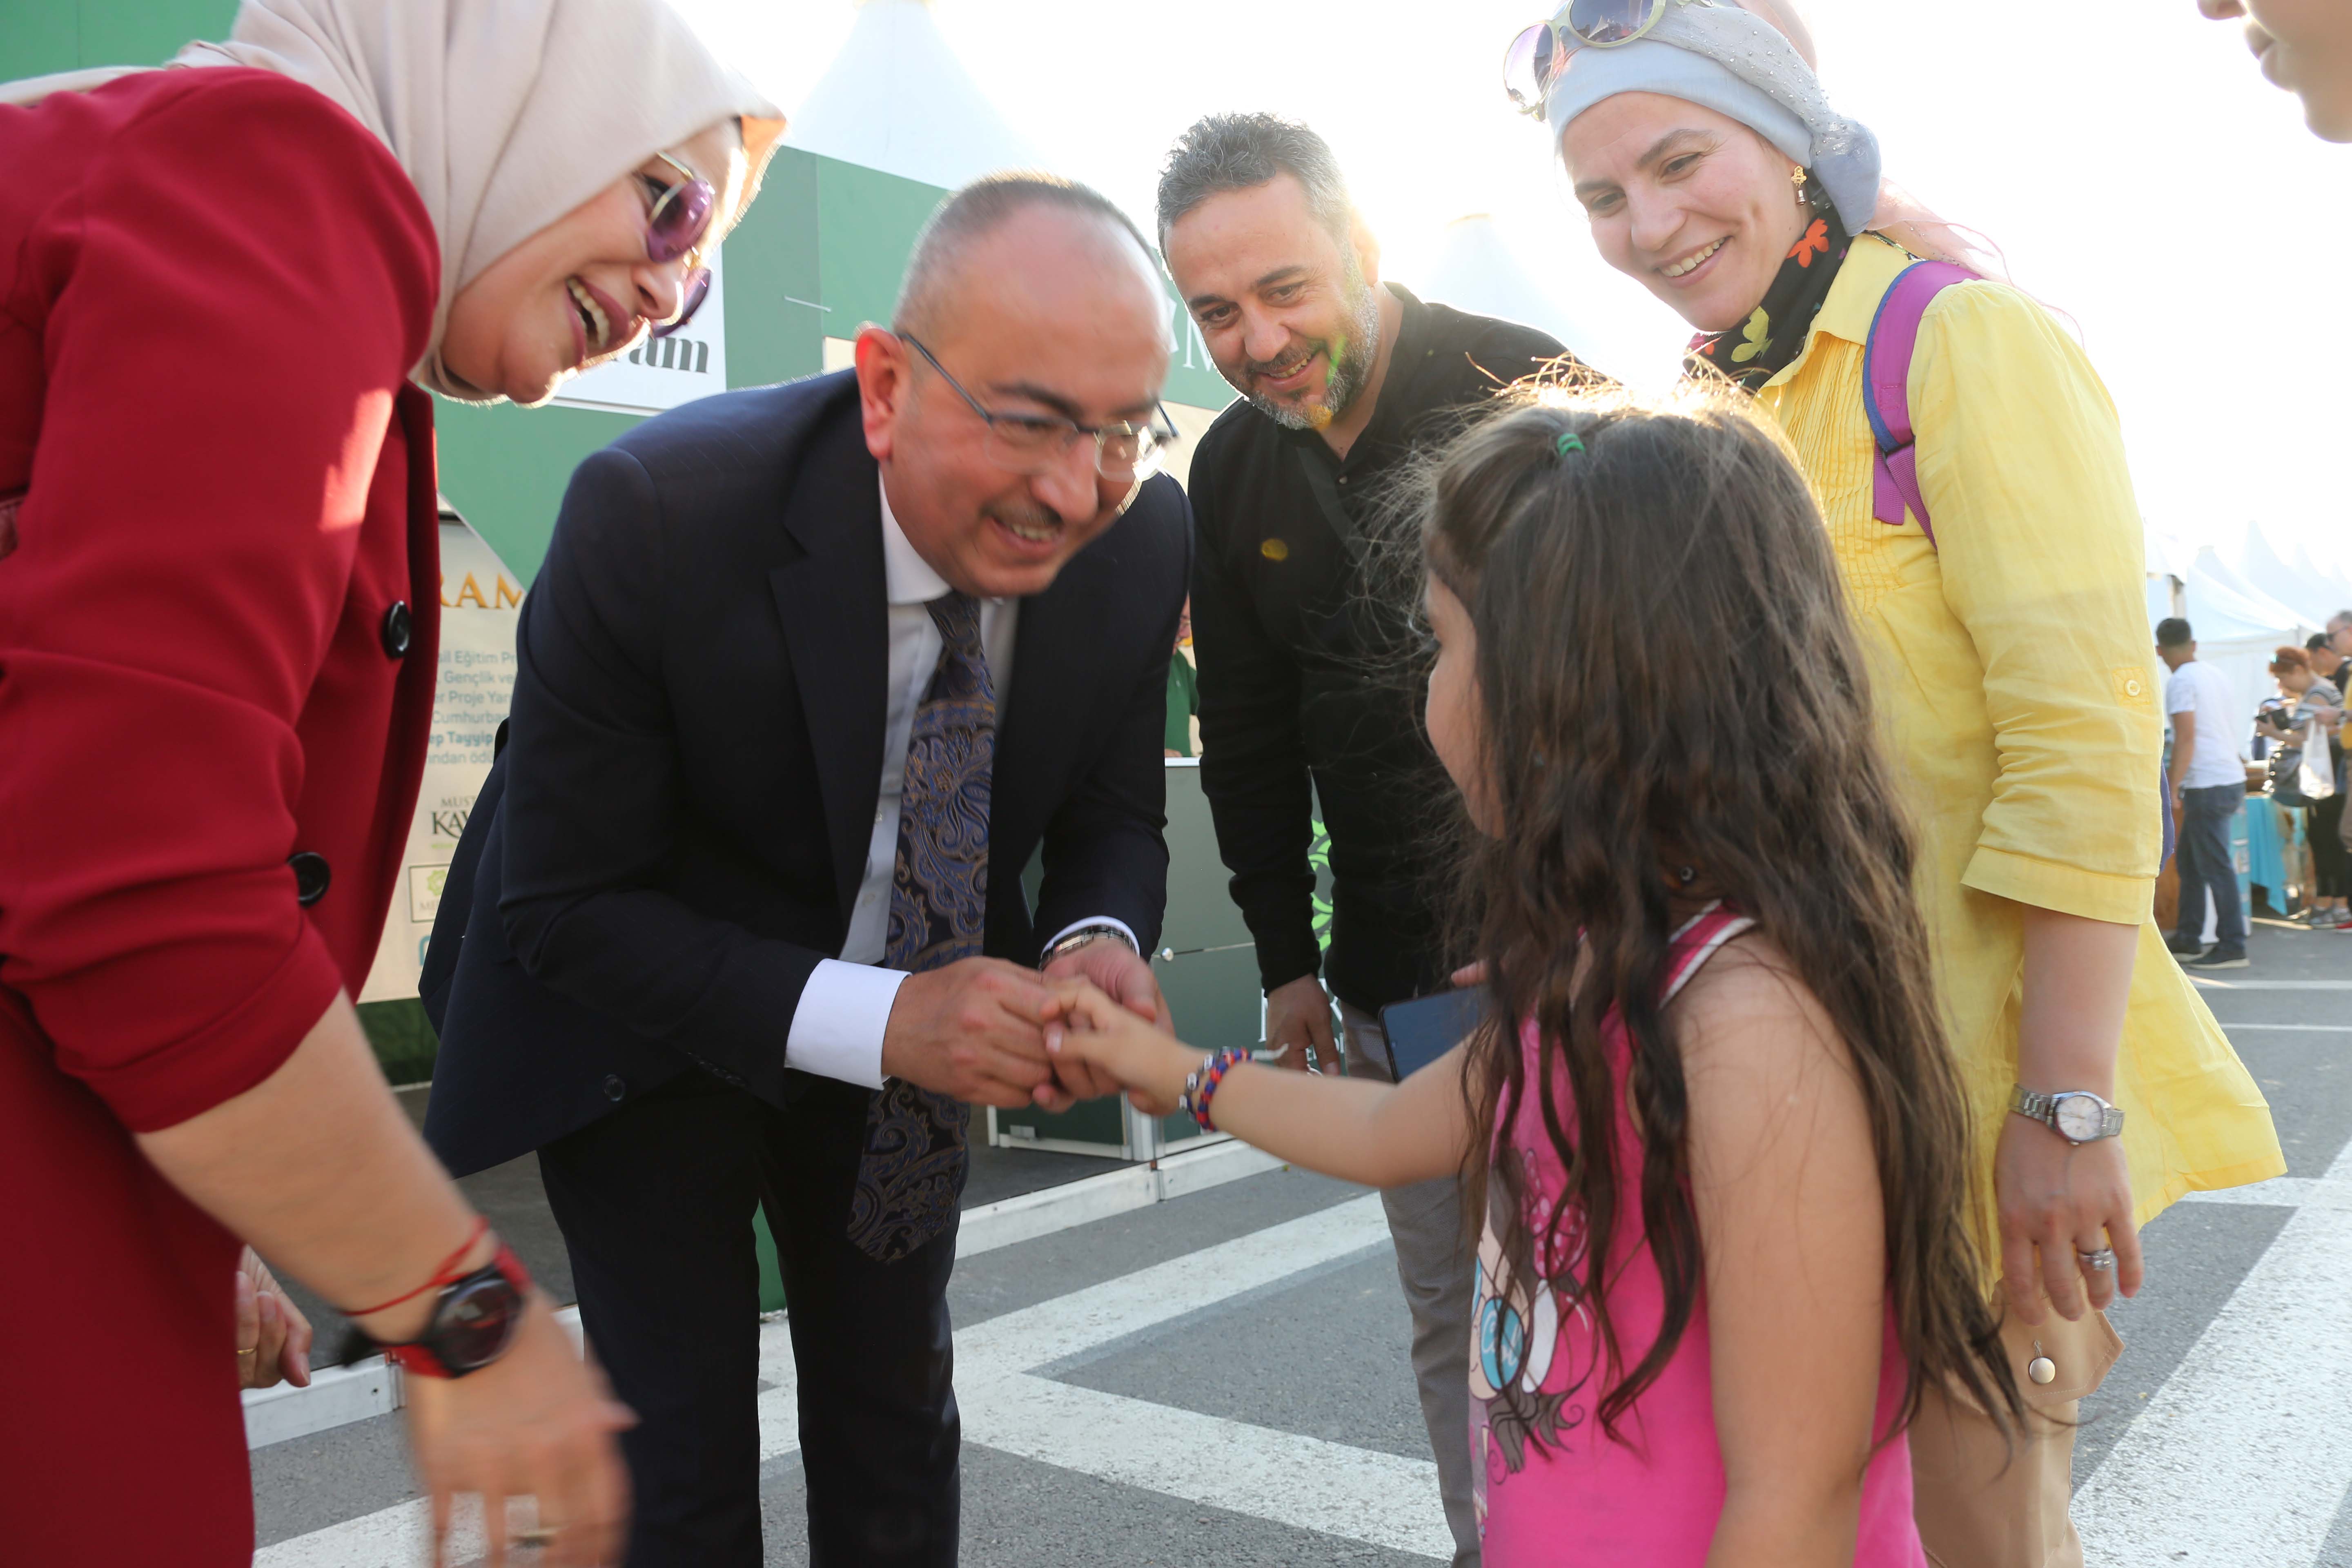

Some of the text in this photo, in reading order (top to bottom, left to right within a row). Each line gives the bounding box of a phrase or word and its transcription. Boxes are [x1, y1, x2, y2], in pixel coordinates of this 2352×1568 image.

[628, 334, 710, 373] am
[454, 650, 498, 667] Eğitim
[444, 670, 494, 686] Gençlik
[448, 690, 484, 707] Proje
[448, 731, 493, 747] Tayyip
